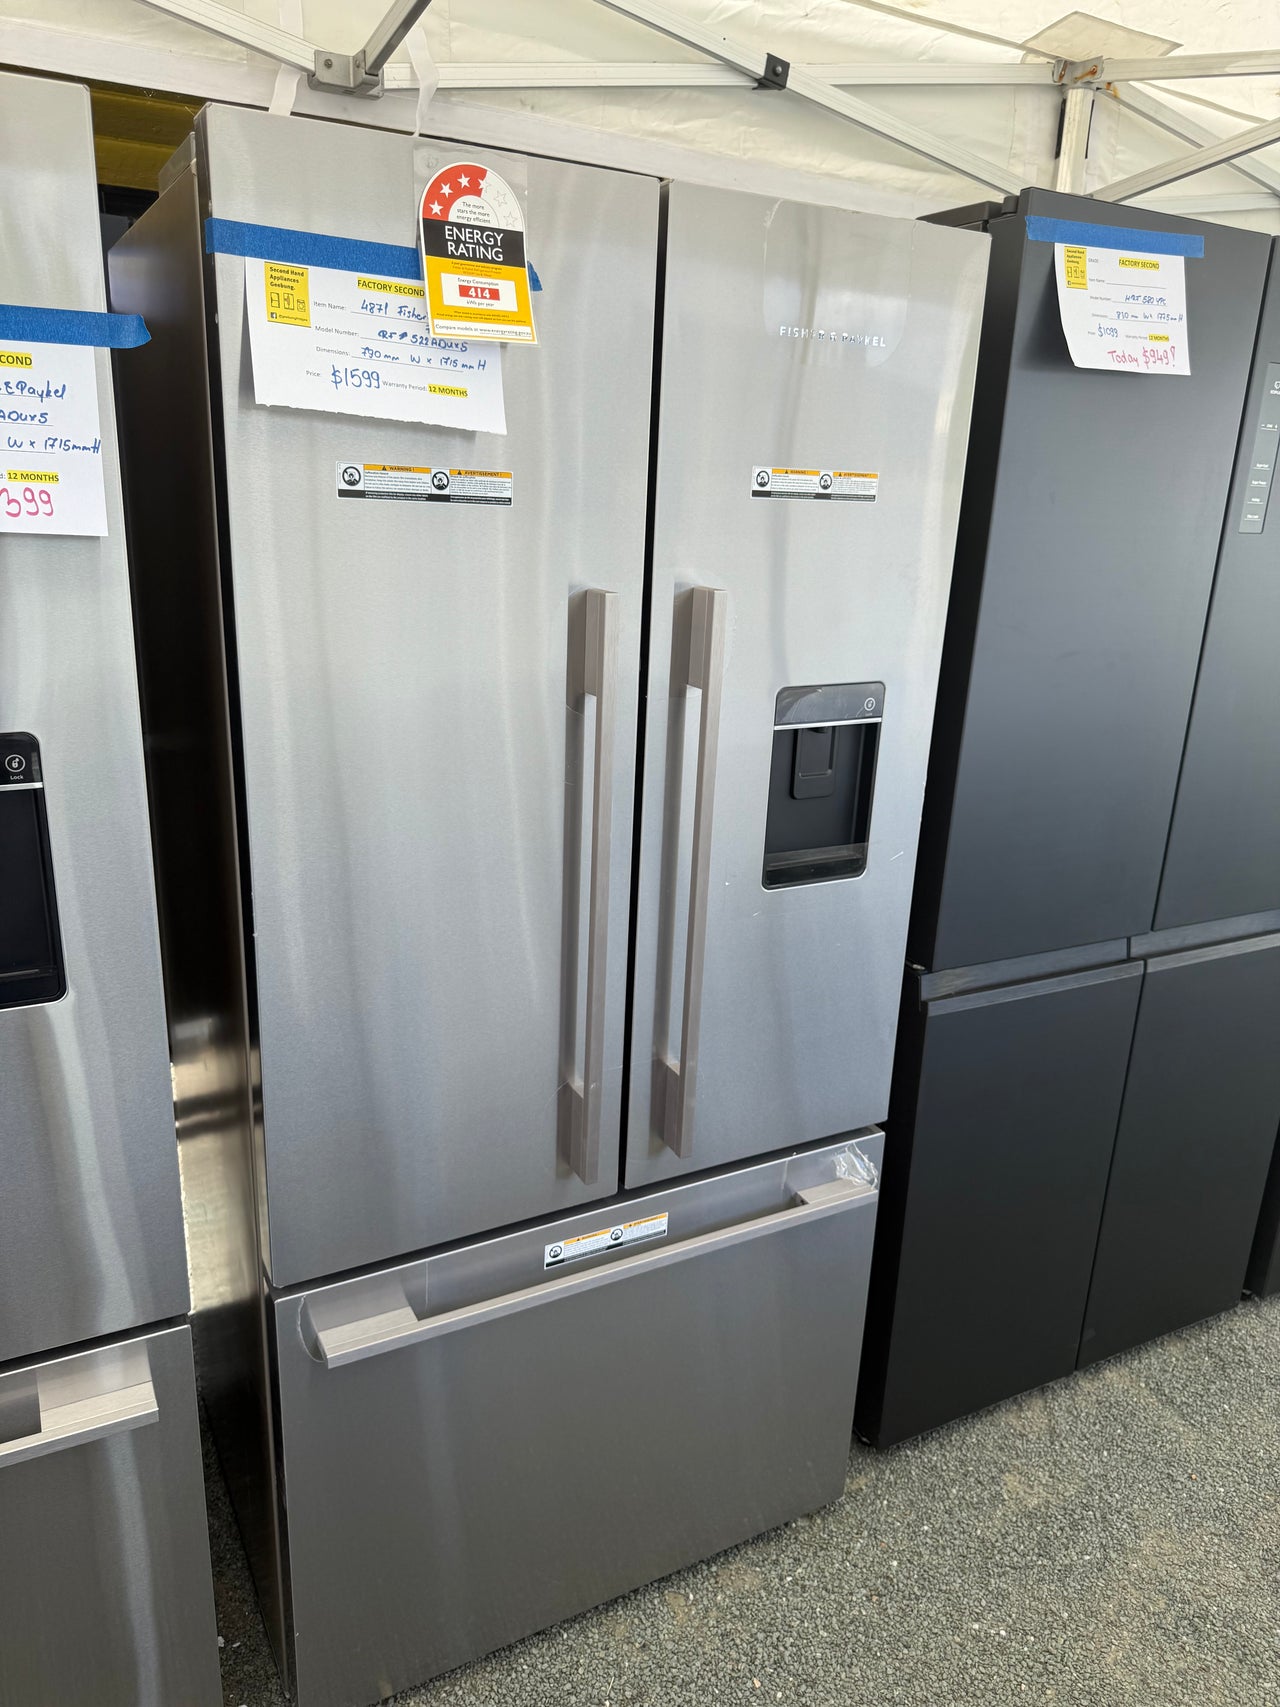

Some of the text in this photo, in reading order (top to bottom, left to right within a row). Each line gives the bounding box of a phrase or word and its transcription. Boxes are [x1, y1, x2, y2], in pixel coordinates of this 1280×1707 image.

[444, 225, 504, 246] ENERGY
[447, 241, 504, 262] RATING
[270, 266, 289, 275] Second
[270, 274, 299, 284] Appliances
[357, 280, 425, 297] FACTORY SECOND
[468, 287, 490, 299] 414
[779, 326, 825, 340] FISHER
[842, 332, 886, 347] PAYKEL
[1107, 350, 1140, 368] Today
[331, 364, 380, 390] $1599
[382, 379, 408, 390] Warranty
[438, 387, 468, 397] MONTHS
[8, 472, 18, 480] 12
[20, 473, 60, 482] MONTHS
